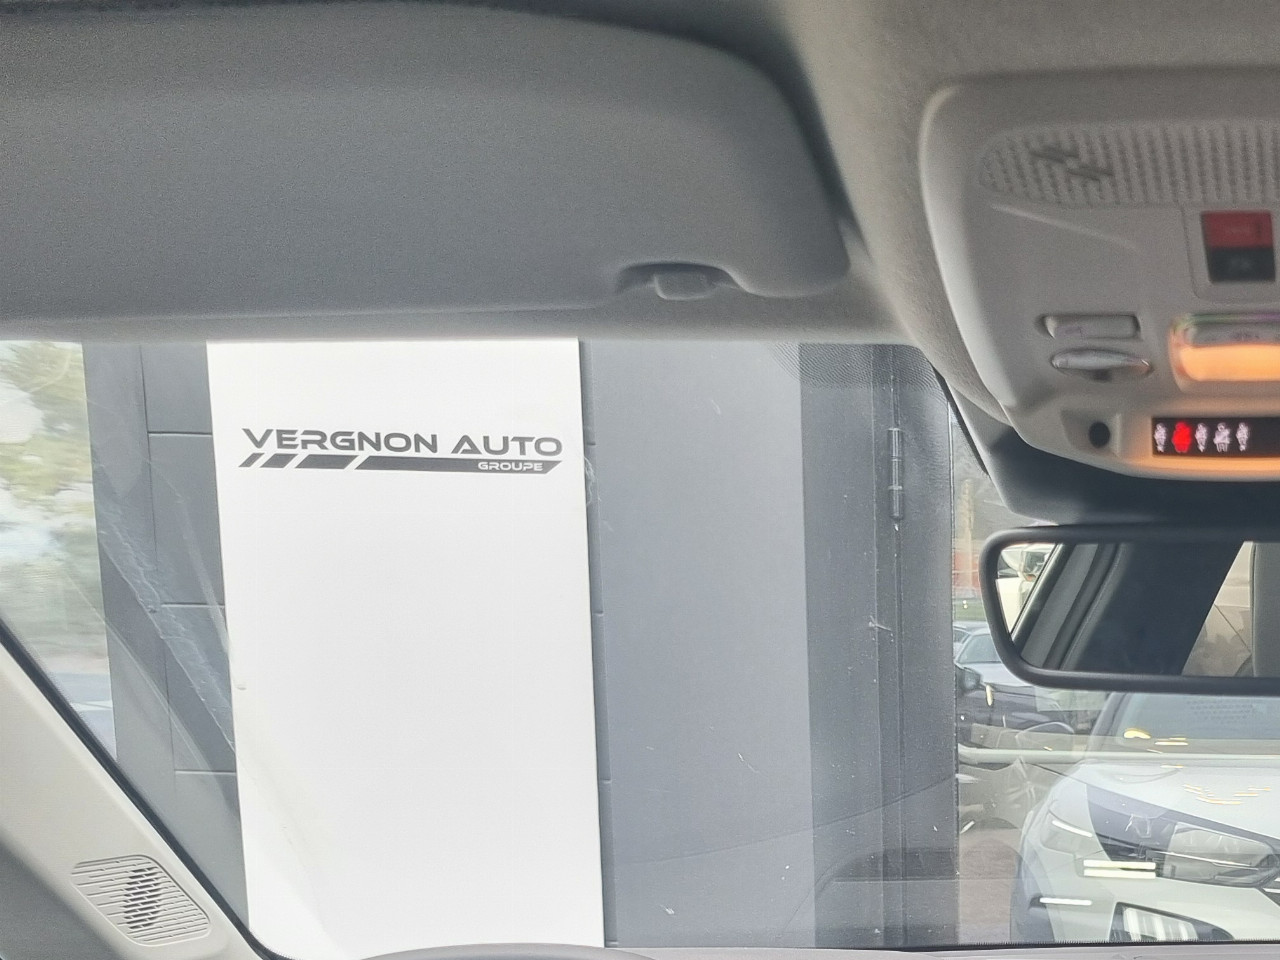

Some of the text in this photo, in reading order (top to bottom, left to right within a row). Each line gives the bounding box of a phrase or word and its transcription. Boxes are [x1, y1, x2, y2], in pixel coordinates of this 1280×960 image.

[242, 428, 563, 456] VERGNON AUTO
[478, 461, 543, 472] GROUPE
